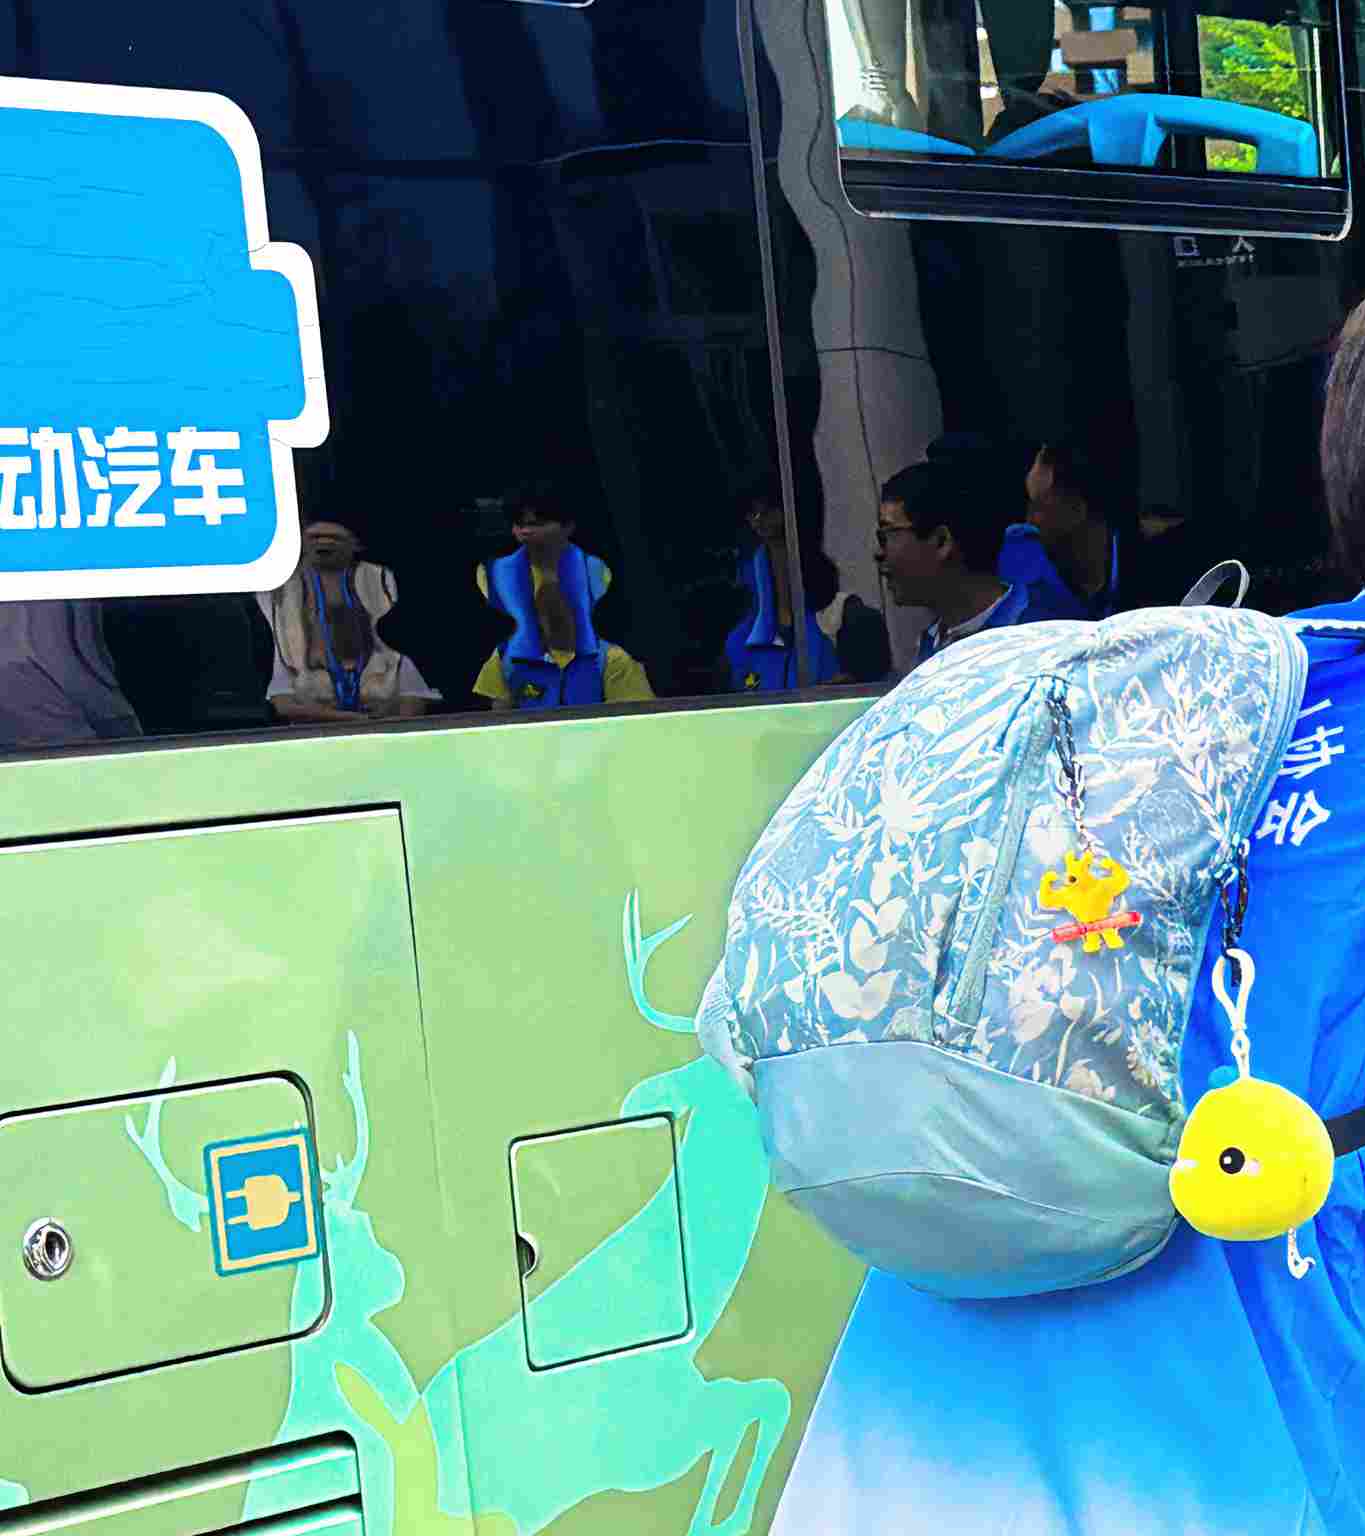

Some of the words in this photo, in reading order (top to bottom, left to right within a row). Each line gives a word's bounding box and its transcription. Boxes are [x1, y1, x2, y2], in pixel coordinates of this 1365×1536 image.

[0, 426, 248, 530] 动汽车
[1255, 698, 1345, 847] 协会
